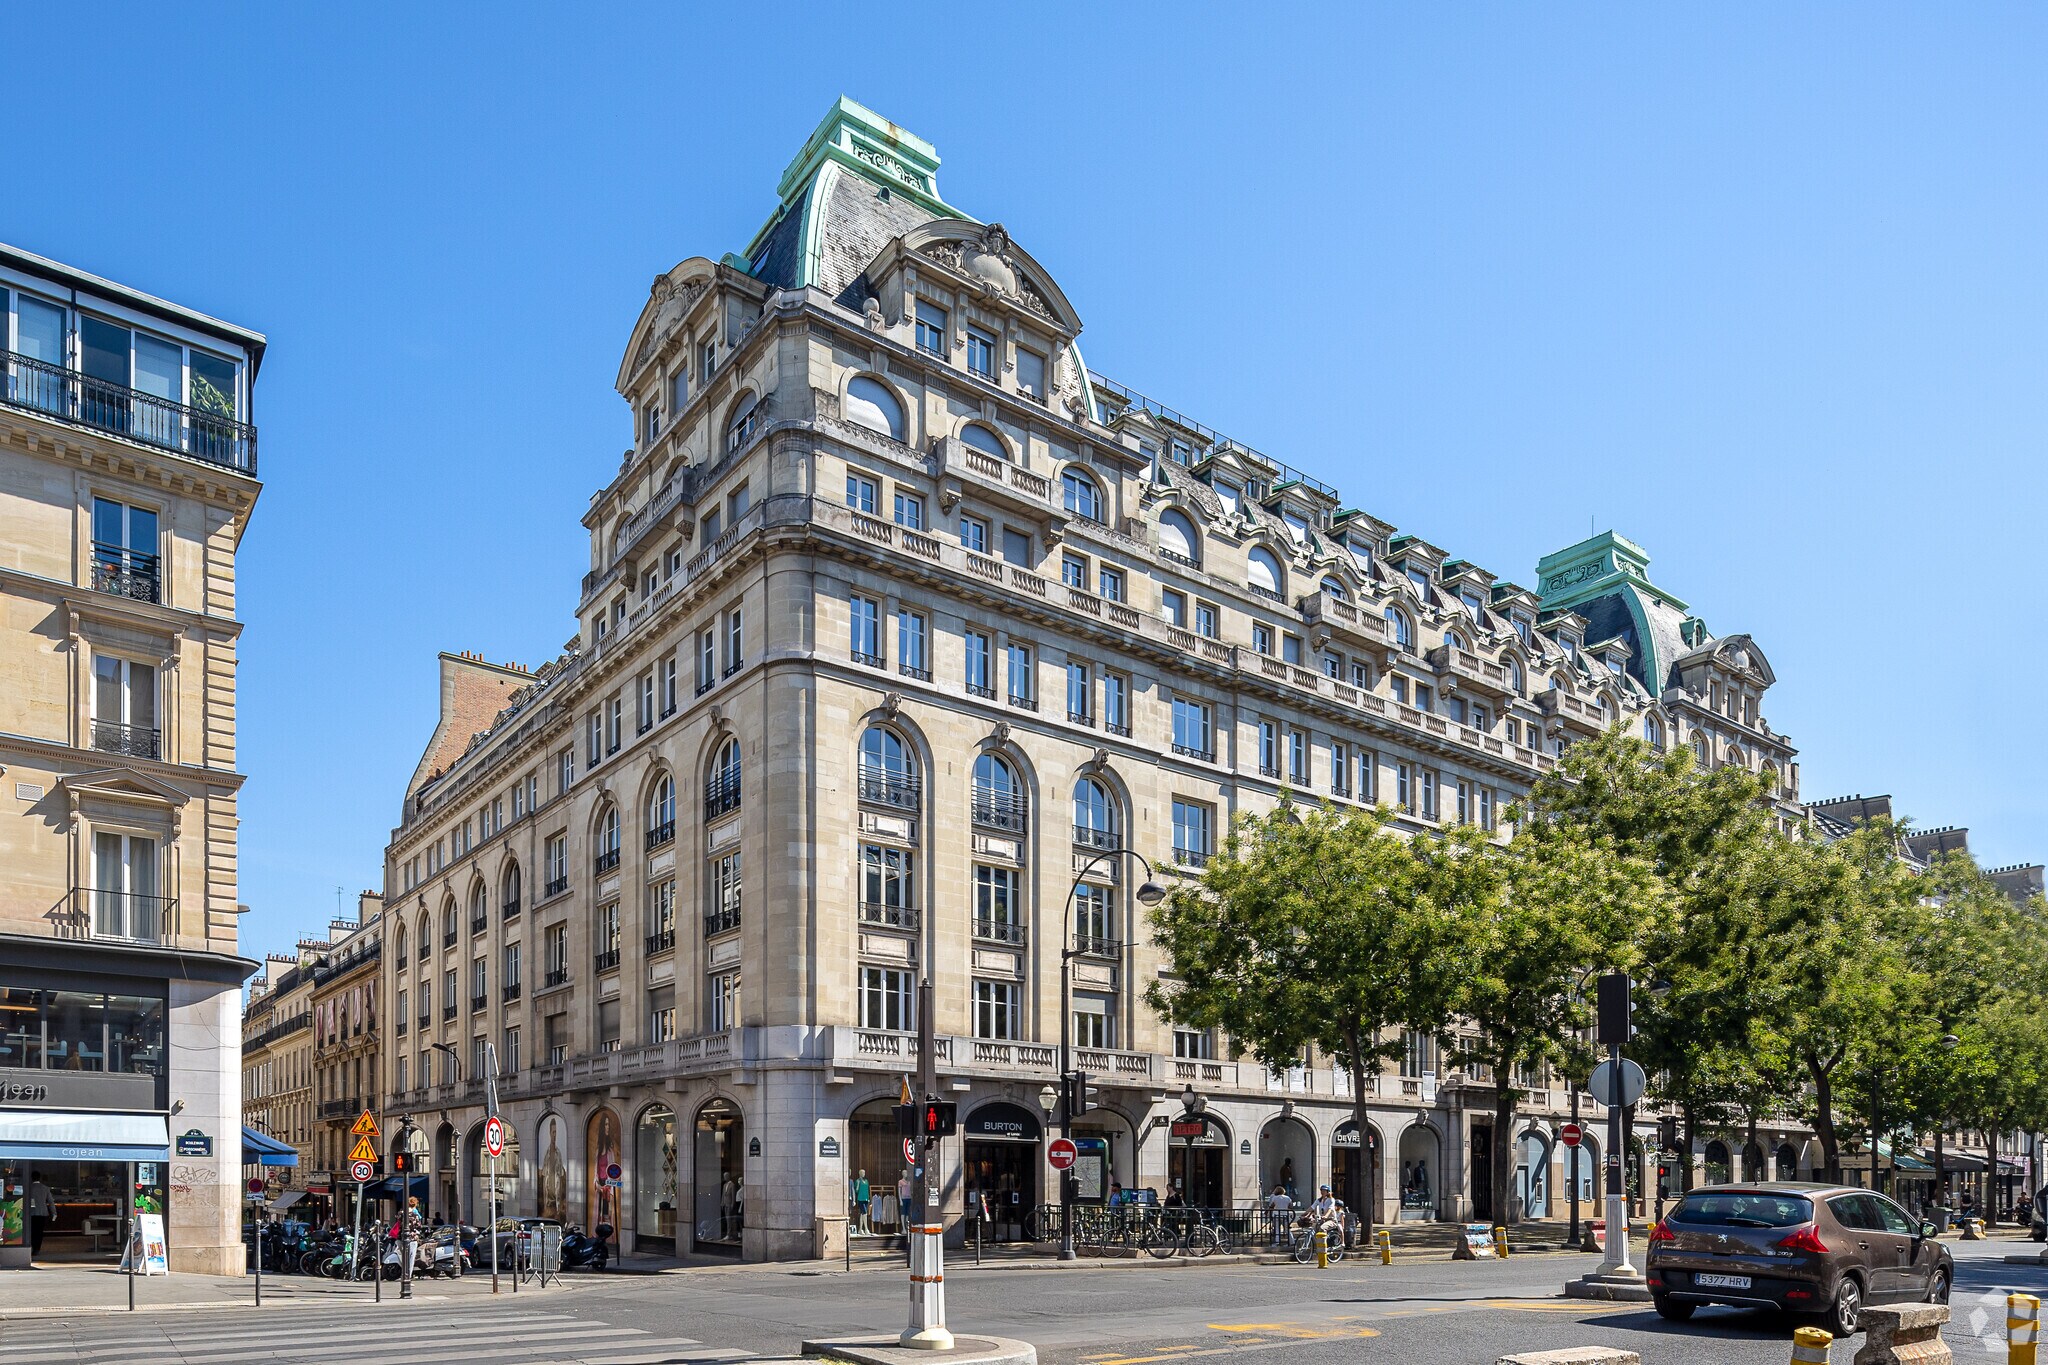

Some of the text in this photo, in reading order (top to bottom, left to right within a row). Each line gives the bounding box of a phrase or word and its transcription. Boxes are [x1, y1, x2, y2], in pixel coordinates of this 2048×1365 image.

[0, 1079, 48, 1099] jean
[984, 1121, 1023, 1131] BURTON
[489, 1127, 500, 1146] 30
[1337, 1134, 1361, 1142] DEVRE
[62, 1147, 103, 1159] cojean
[356, 1166, 369, 1176] 30
[1701, 1273, 1750, 1287] 5377 HRV
